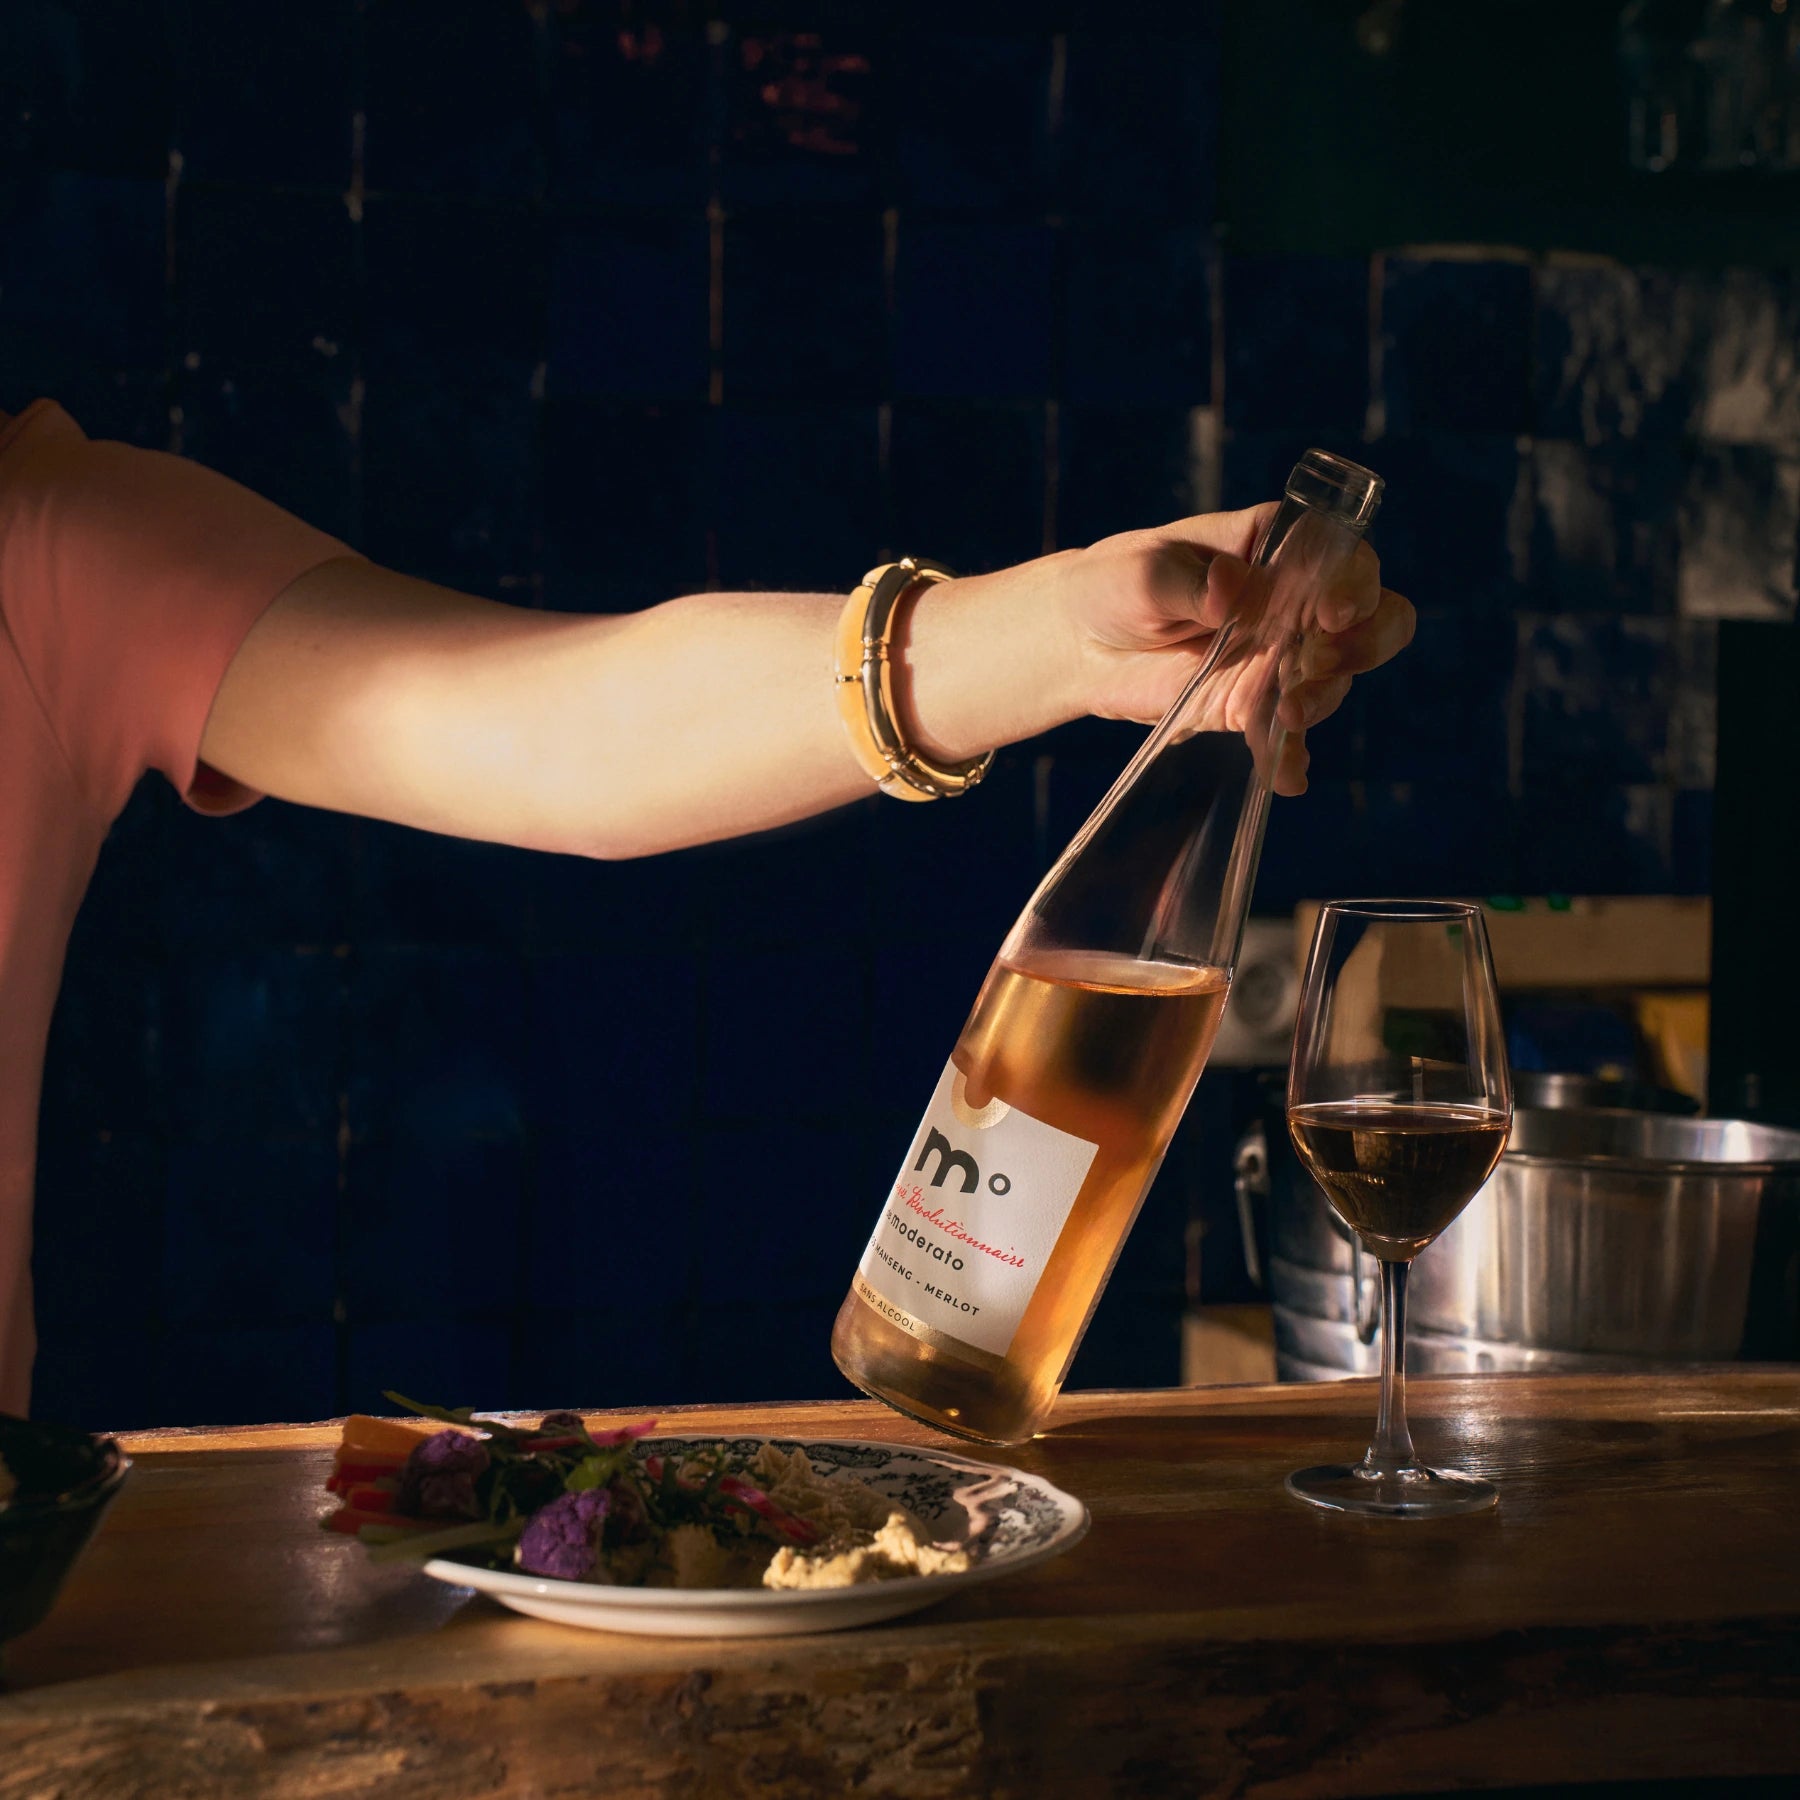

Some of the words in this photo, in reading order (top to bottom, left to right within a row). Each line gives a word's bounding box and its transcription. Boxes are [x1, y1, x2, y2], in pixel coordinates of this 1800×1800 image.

[891, 1214, 964, 1271] moderato
[859, 1283, 877, 1303] SANS
[878, 1300, 915, 1331] ALCOOL
[876, 1244, 913, 1280] MANSENG
[924, 1282, 980, 1316] MERLOT
